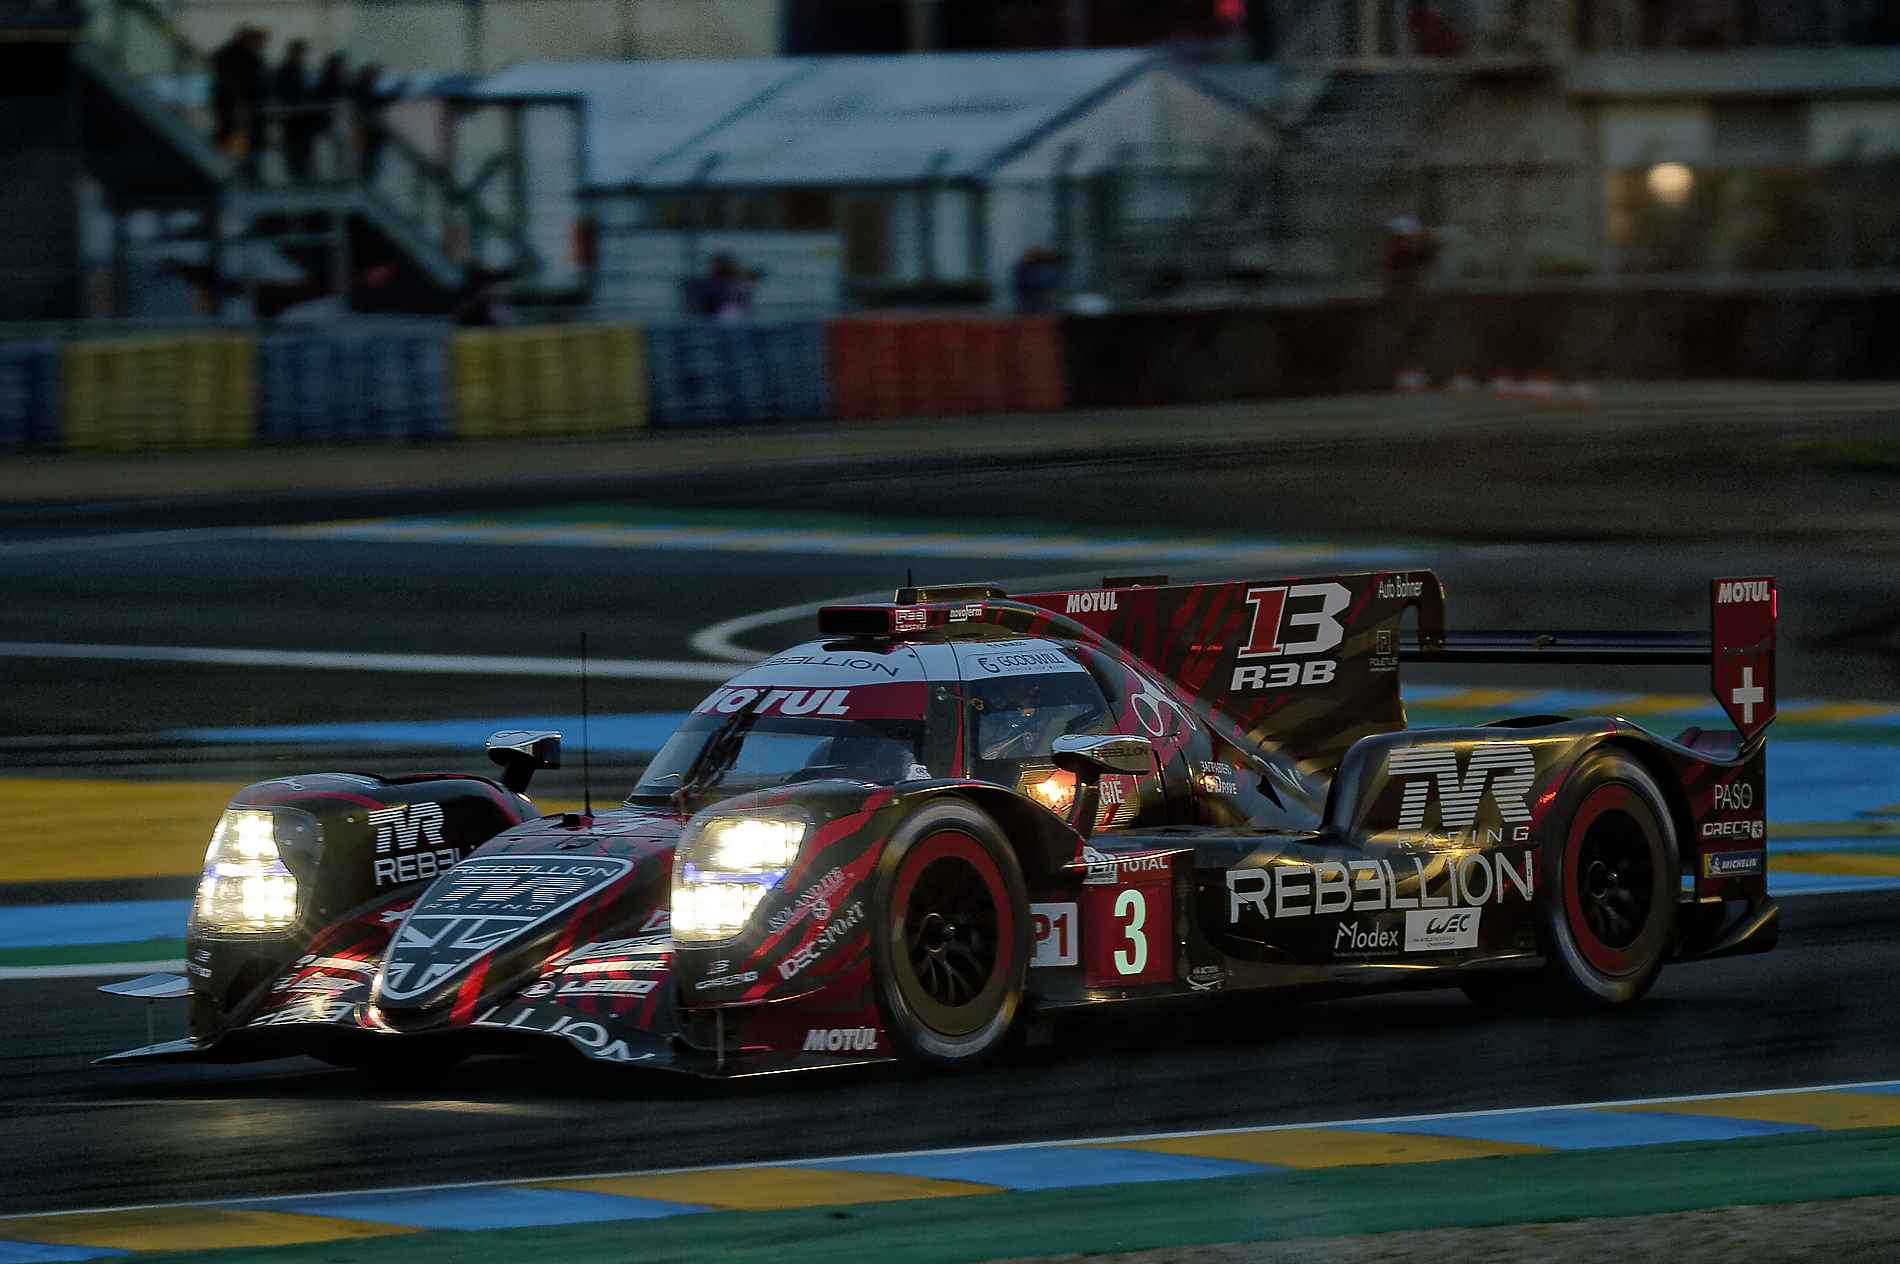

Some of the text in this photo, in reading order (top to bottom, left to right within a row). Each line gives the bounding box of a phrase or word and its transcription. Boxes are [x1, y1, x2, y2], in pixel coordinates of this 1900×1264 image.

[1066, 591, 1119, 614] MOTUL
[1717, 580, 1771, 604] MOTUL
[1237, 582, 1352, 659] 13
[1229, 659, 1337, 692] R3B
[1713, 783, 1753, 810] PASO
[1120, 855, 1169, 873] TOTAL
[1112, 888, 1149, 976] 3
[1334, 921, 1400, 949] Modex
[1426, 913, 1472, 934] WEC
[802, 1028, 879, 1051] MOTUL
